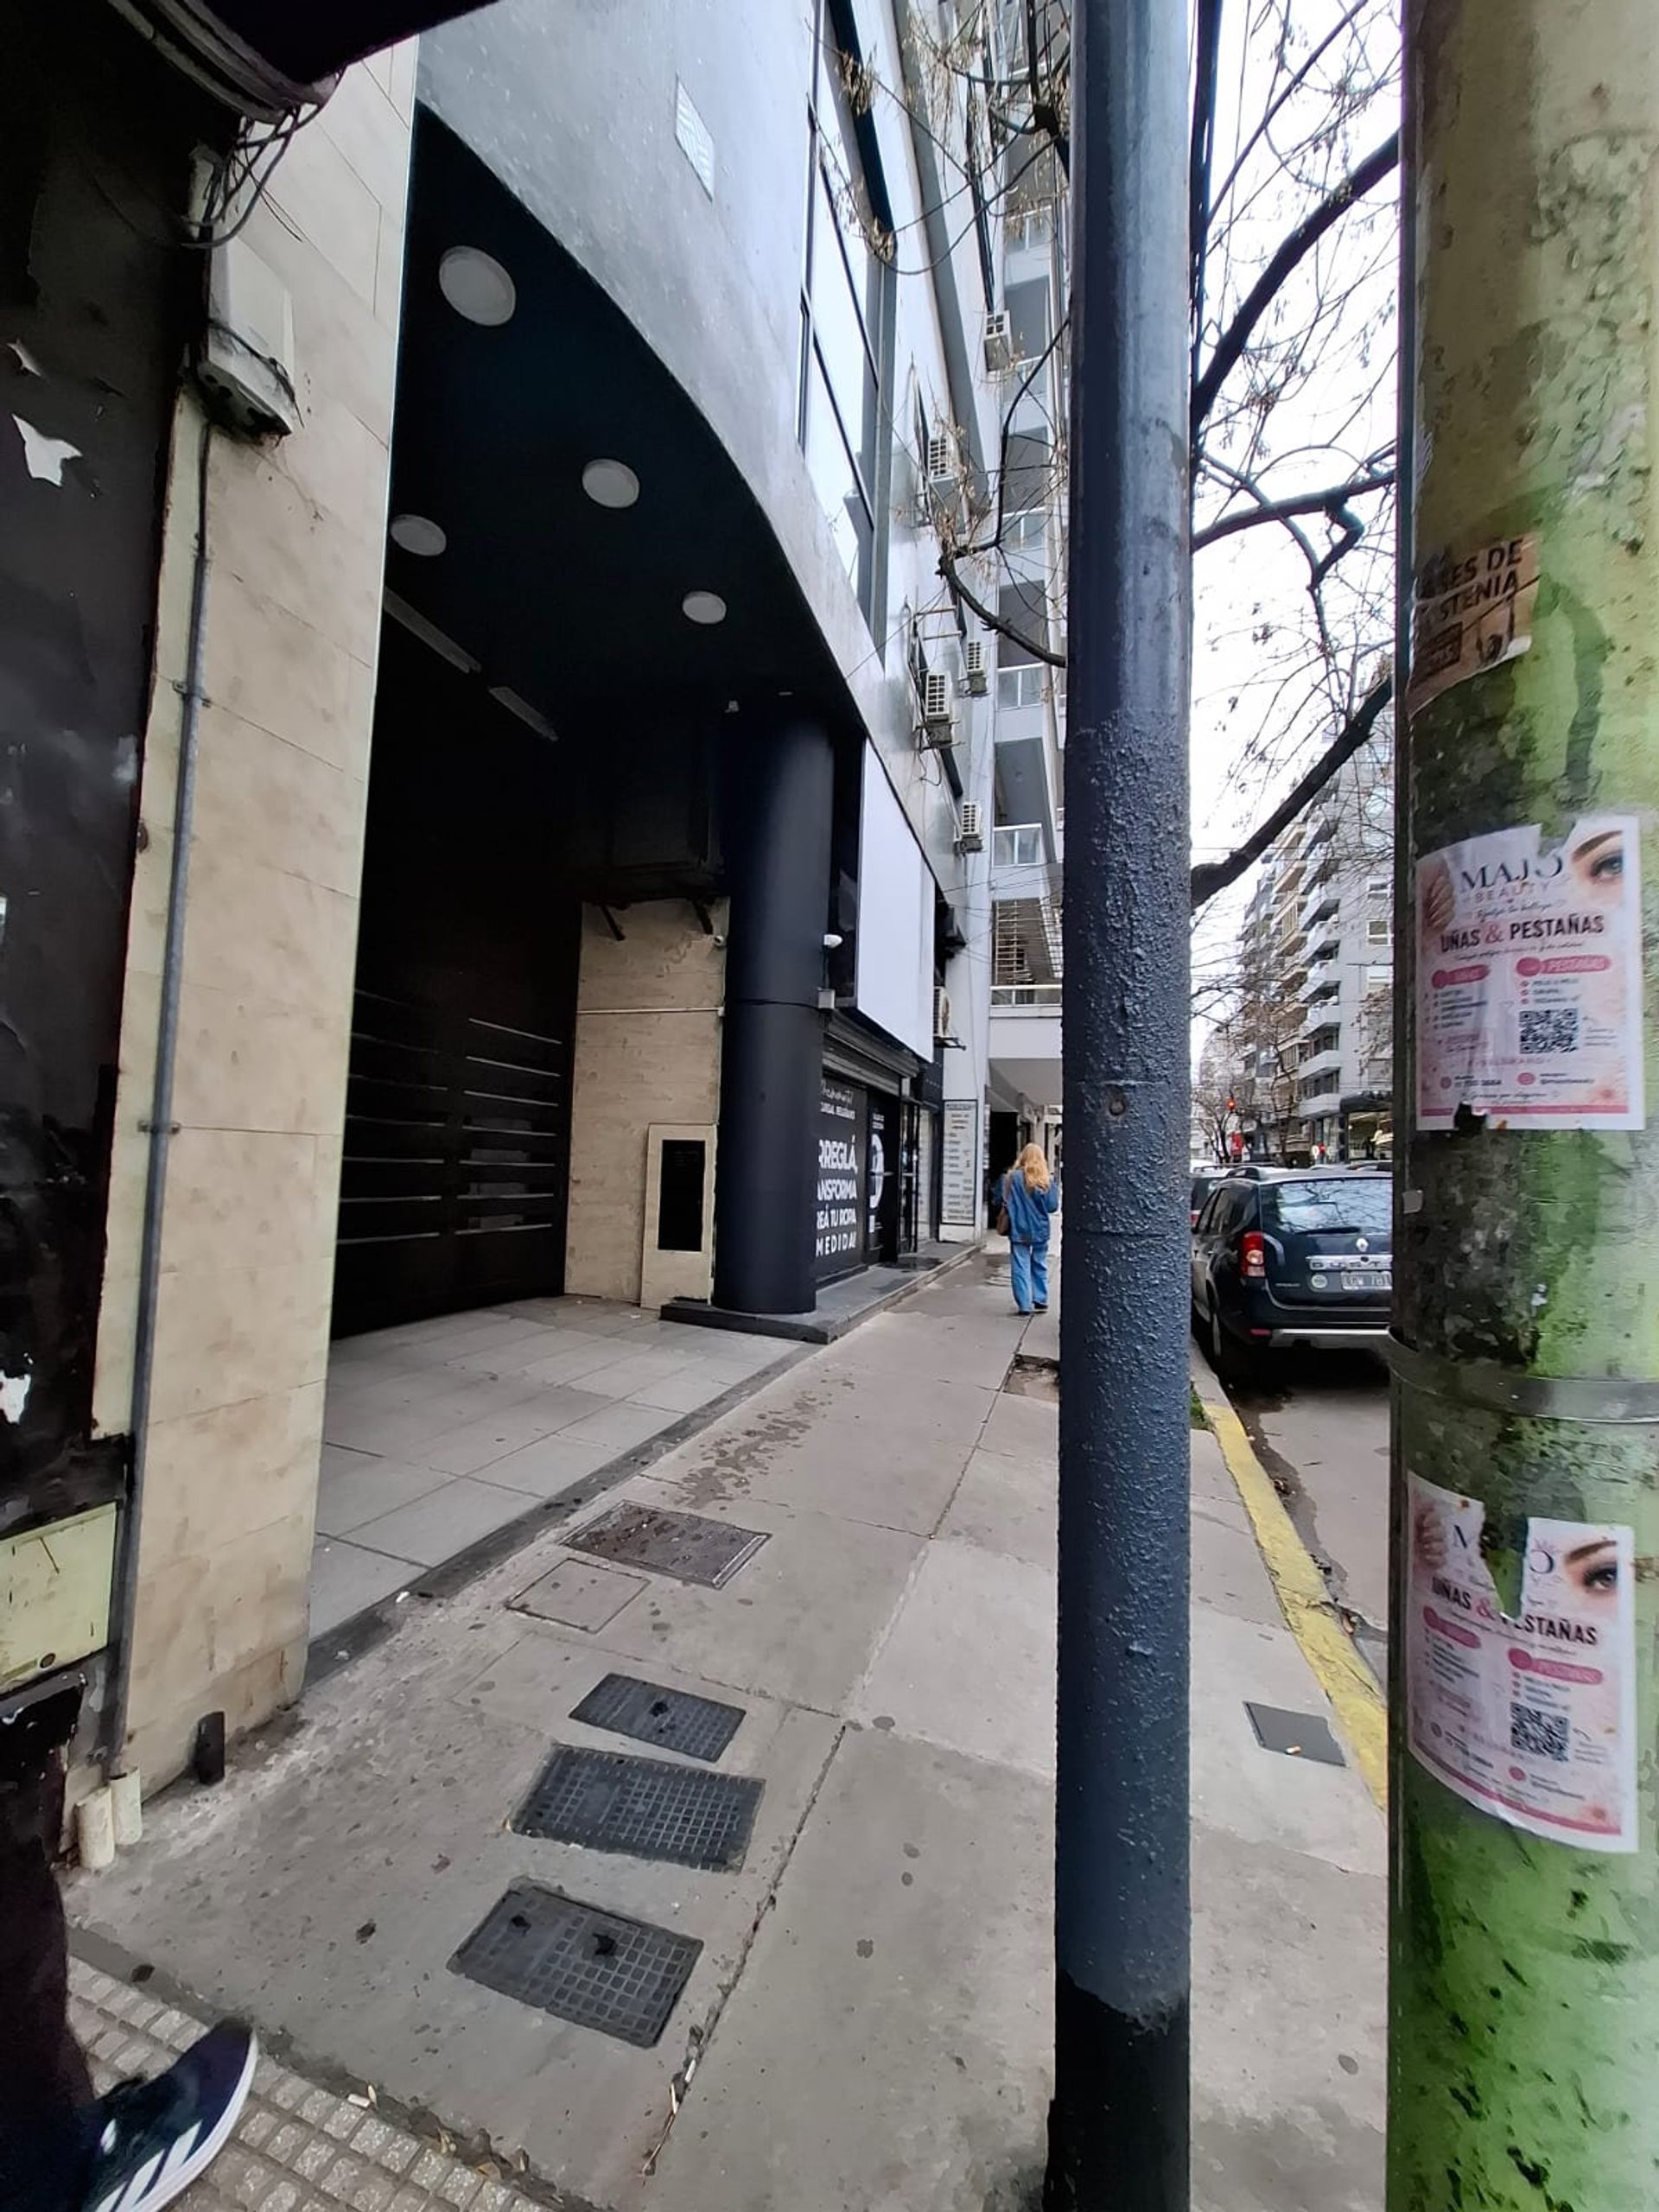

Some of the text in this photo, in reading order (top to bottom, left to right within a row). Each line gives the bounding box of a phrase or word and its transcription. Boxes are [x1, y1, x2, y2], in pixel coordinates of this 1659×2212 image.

[1487, 538, 1524, 572] DE
[1432, 569, 1518, 622] STENIA
[1440, 928, 1481, 953] UÑAS
[1484, 924, 1505, 944] &
[1510, 912, 1605, 941] PESTAÑAS
[1431, 1575, 1471, 1611] UÑAS
[1502, 1612, 1599, 1646] STAÑAS
